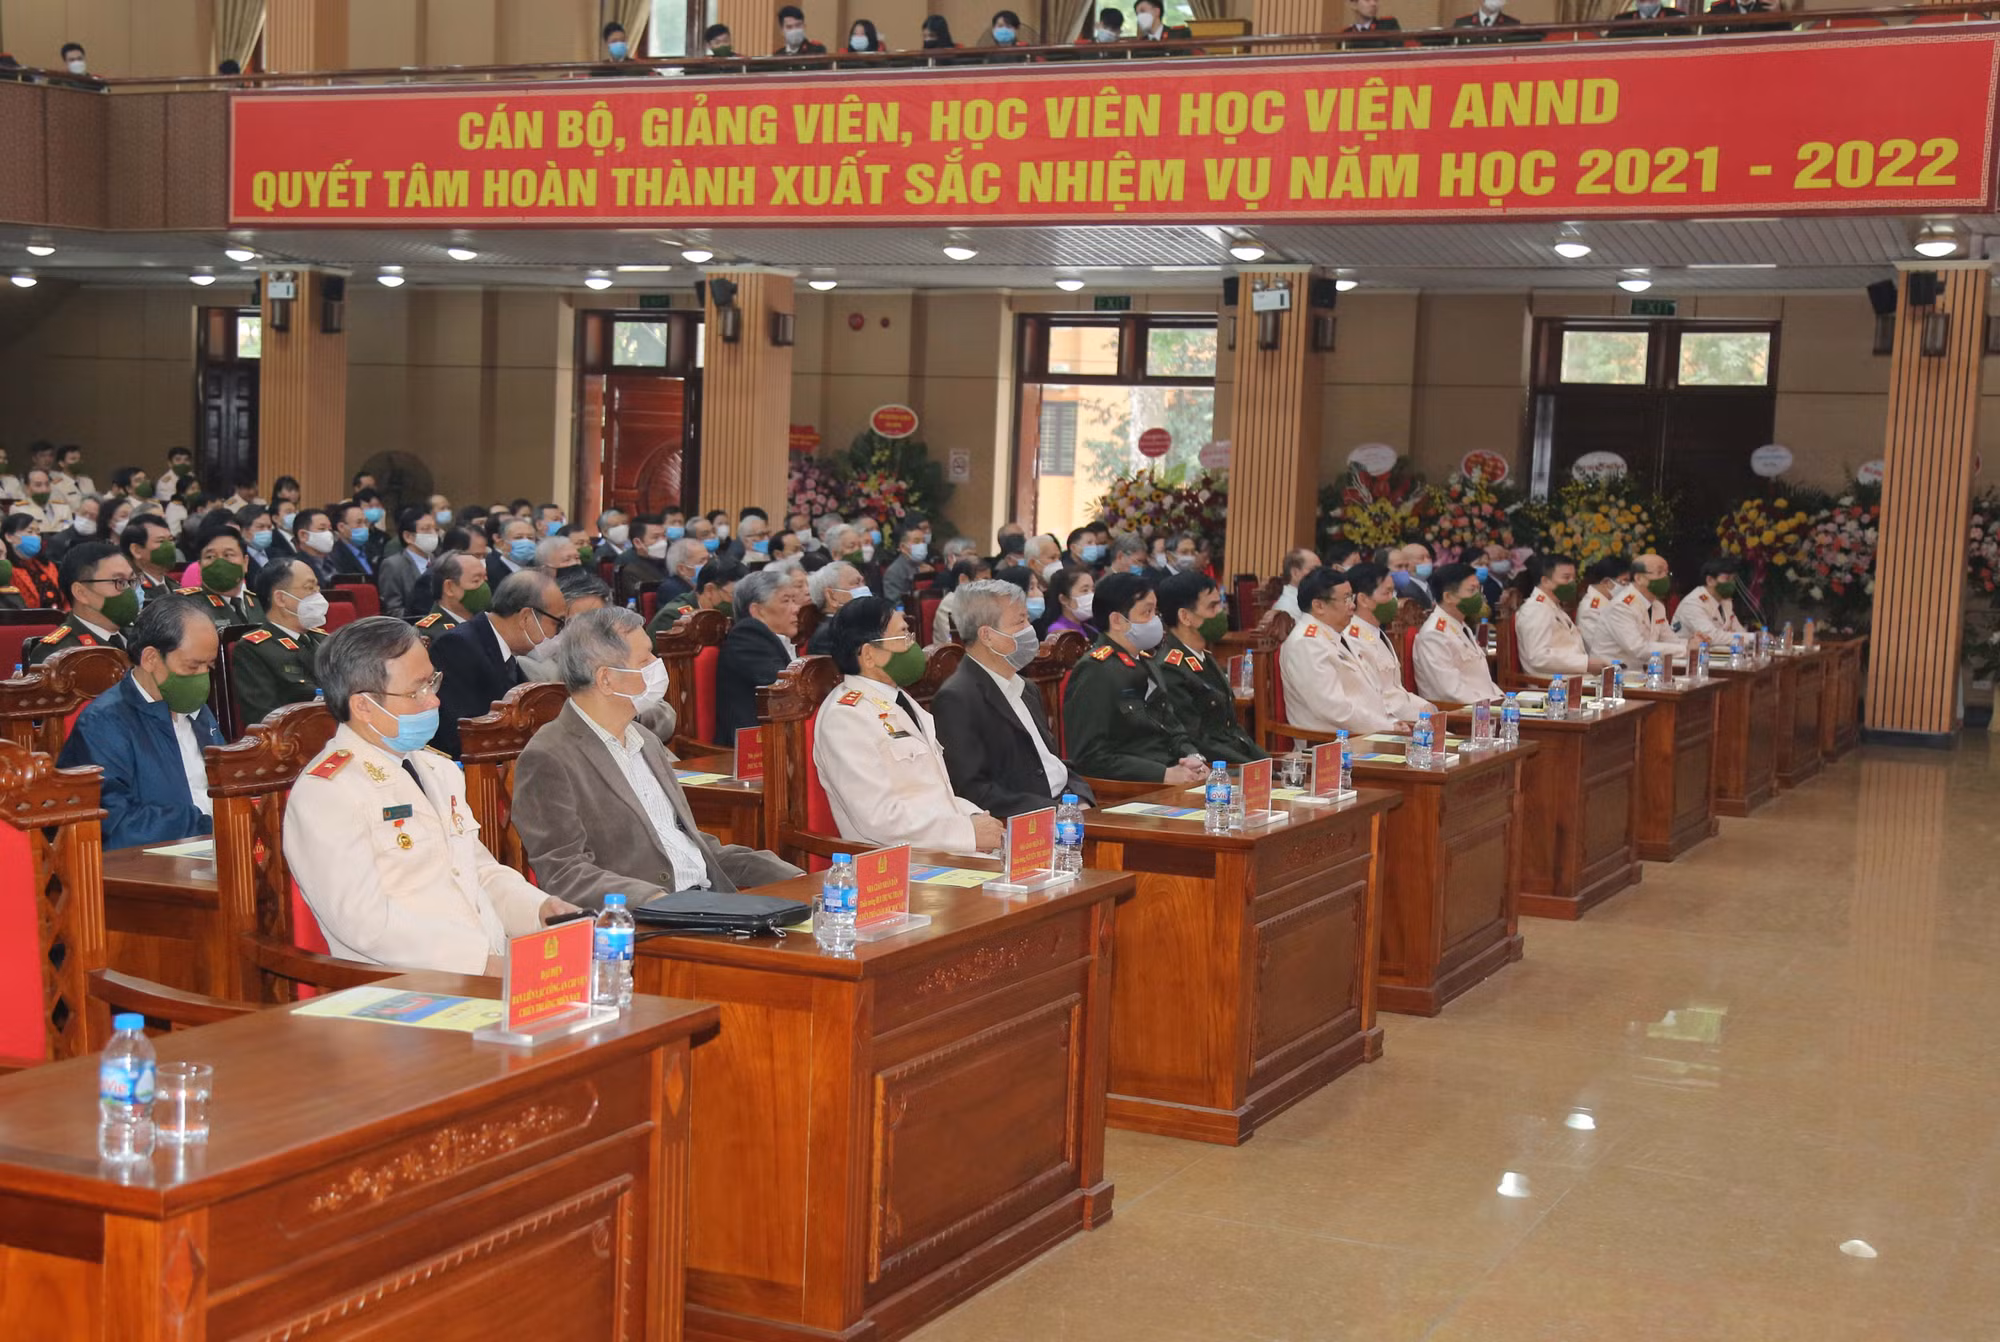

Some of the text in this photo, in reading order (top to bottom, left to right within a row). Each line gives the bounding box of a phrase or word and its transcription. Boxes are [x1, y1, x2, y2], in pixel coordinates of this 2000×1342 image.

[459, 77, 1619, 156] CÁN BỘ, GIẢNG VIÊN, HỌC VIÊN HỌC VIỆN ANND
[252, 137, 1959, 212] QUYẾT TÂM HOÀN THÀNH XUẤT SẮC NHIỆM VỤ NĂM HỌC 2021 - 2022
